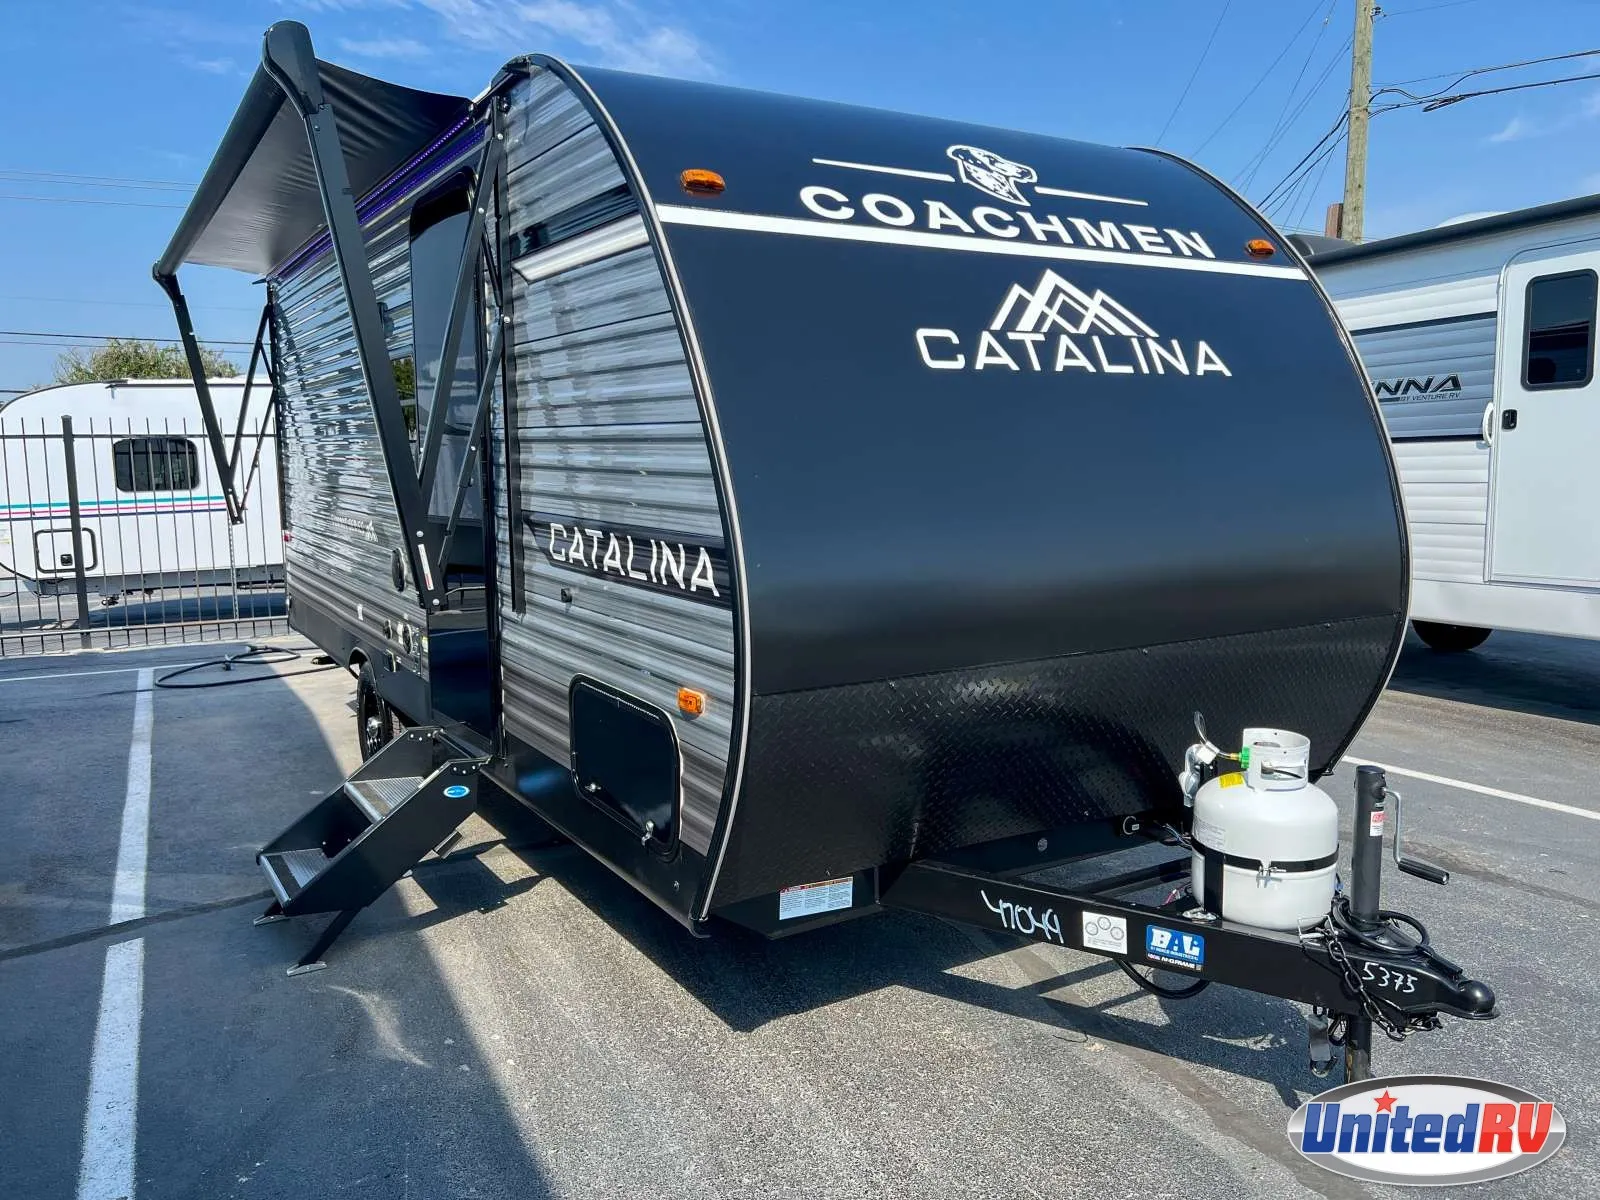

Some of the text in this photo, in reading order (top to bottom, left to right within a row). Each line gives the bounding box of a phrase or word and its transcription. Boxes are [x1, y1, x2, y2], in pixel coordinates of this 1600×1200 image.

[799, 185, 1216, 259] COACHMEN
[915, 328, 1233, 377] CATALINA
[1370, 373, 1462, 397] NNA
[1412, 393, 1448, 401] VENTURE
[1449, 392, 1461, 400] RV
[549, 522, 721, 598] CATALINA
[1151, 928, 1201, 957] BAL
[1361, 961, 1419, 994] 5375
